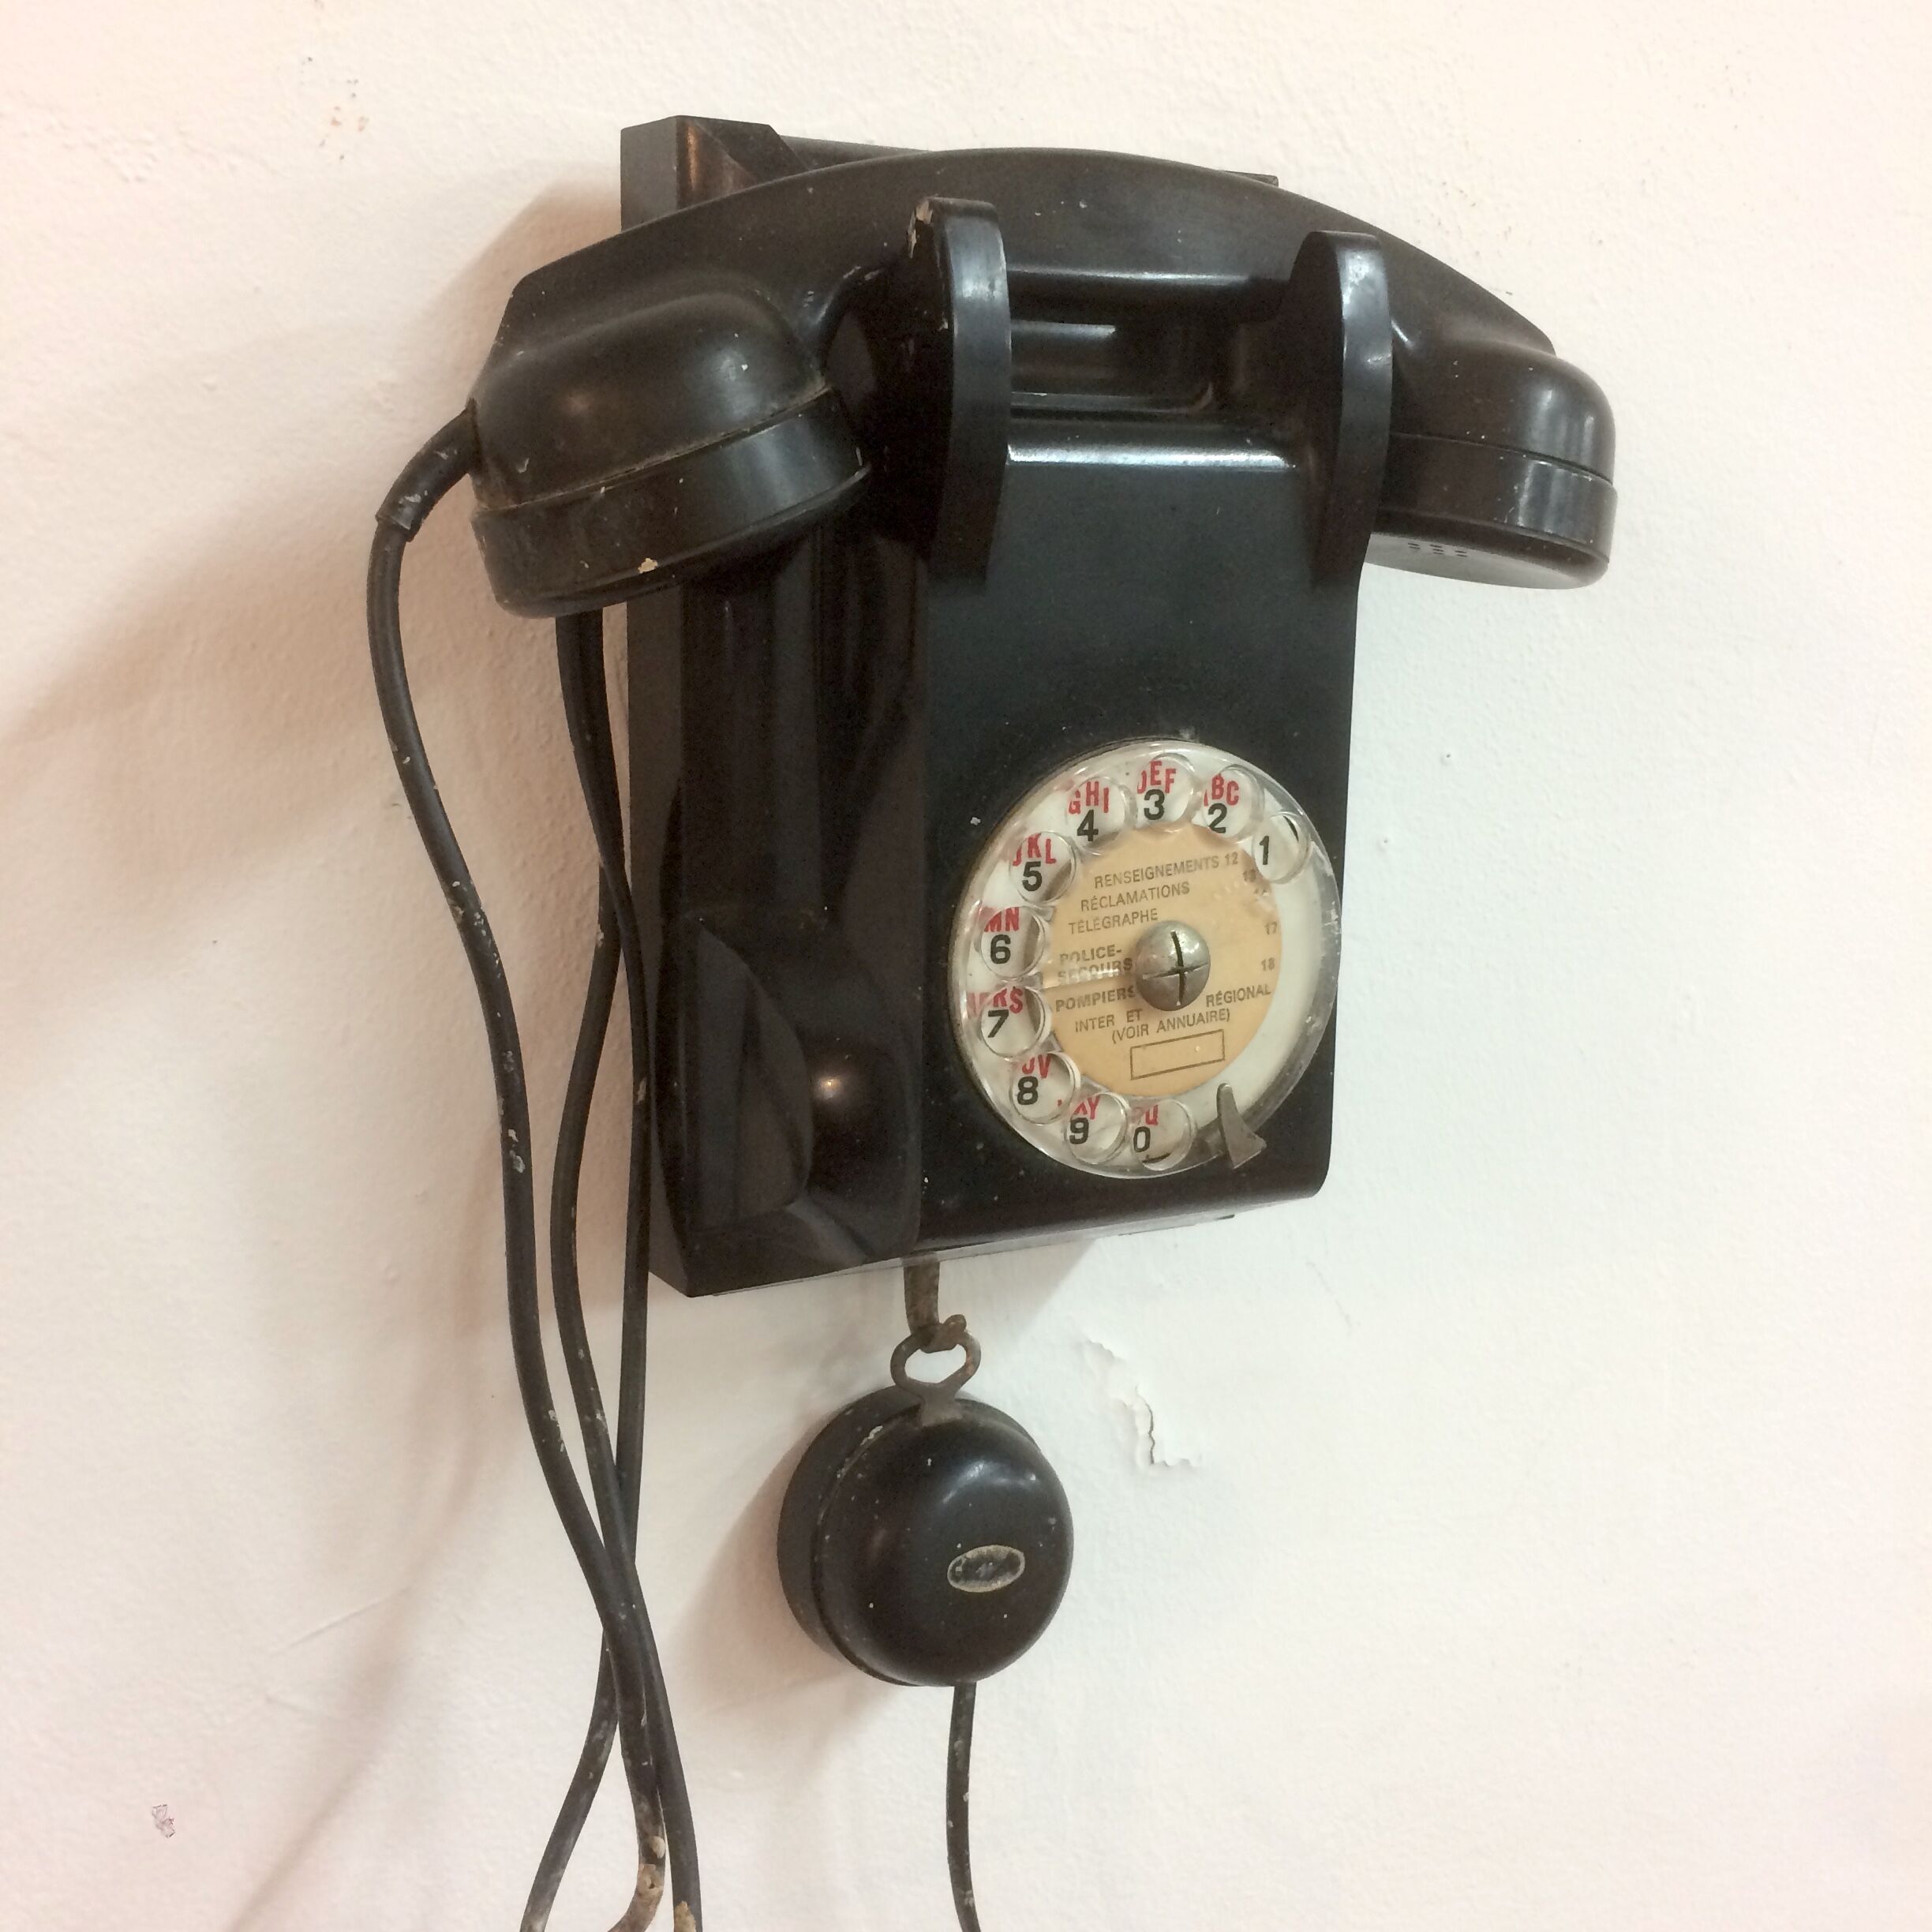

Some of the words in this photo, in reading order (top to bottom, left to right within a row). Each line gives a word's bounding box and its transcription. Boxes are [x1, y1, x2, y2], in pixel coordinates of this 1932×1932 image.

[1144, 788, 1166, 821] 3
[1208, 802, 1228, 834] 2
[1076, 809, 1099, 842] 4
[1259, 835, 1270, 866] 1
[1021, 860, 1043, 892] 5
[1094, 855, 1220, 889] RENSEIGNEMENTS
[1224, 851, 1239, 867] 12
[1080, 881, 1191, 912] RÉCLAMATIONS
[1068, 908, 1159, 934] TÉLÉGRAPHE
[1264, 921, 1278, 935] 17
[990, 934, 1012, 964] 6
[987, 1009, 1009, 1039] 7
[1074, 1013, 1115, 1034] INTER
[1125, 1008, 1143, 1024] ET
[1205, 983, 1271, 1008] RÉGIONAL
[1111, 1023, 1150, 1044] (VOIR
[1155, 1008, 1231, 1034] ANNUAIRE)
[1017, 1075, 1039, 1106] 8
[1069, 1117, 1090, 1145] 9
[1133, 1125, 1151, 1153] 0
